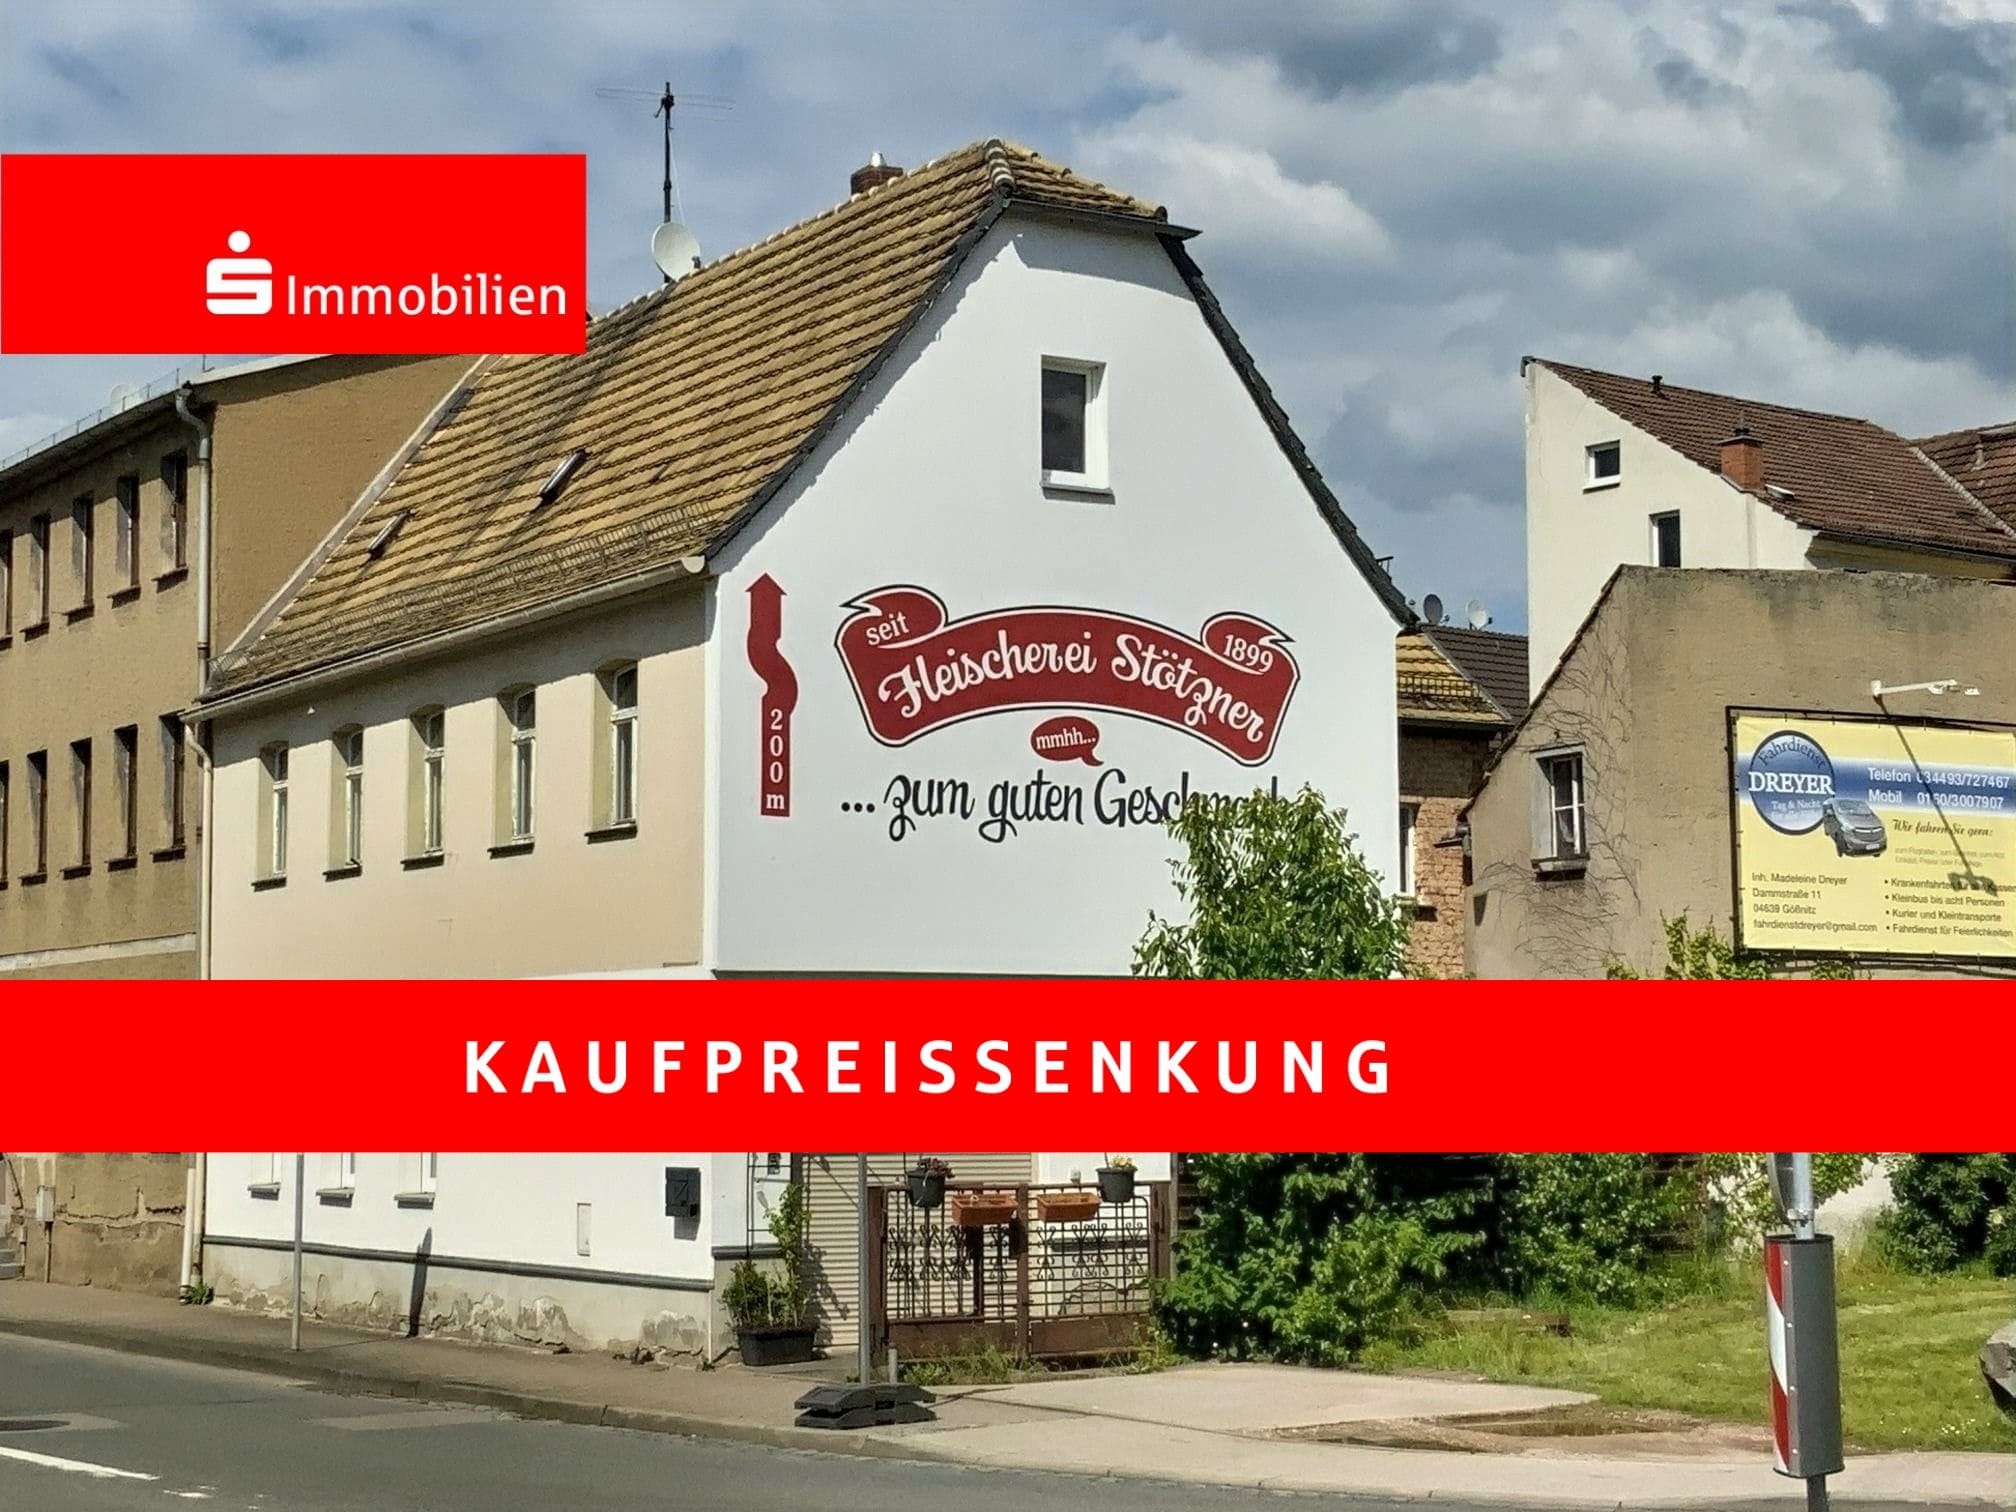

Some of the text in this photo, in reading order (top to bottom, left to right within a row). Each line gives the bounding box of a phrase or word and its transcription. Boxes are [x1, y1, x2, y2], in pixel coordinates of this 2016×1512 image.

[865, 611, 910, 646] seit
[1223, 633, 1274, 673] 1899
[878, 629, 1264, 743] Fleischerei Stötzner
[1758, 736, 1826, 769] Fahrdienst
[1748, 771, 1836, 795] DREYER
[1867, 767, 1912, 783] Telefon
[1868, 789, 1903, 804] Mobil
[884, 773, 975, 842] zum
[978, 769, 1084, 843] guten
[1094, 768, 1284, 830] Gesch
[1892, 819, 1912, 832] Wir
[1915, 821, 1949, 835] fahren
[1952, 822, 1964, 835] Sie
[1752, 872, 1848, 886] Inh. Madeleine Dreyer
[1752, 887, 1822, 899] Dammstraße 11
[1891, 893, 2005, 908] Kleinbus bis acht Personen
[1892, 908, 2002, 924] Kurier und Kleintransporte
[1753, 919, 1878, 933] fahrdienstdreyer@gmail.com
[1892, 923, 2014, 938] Fahrdienst für Feierlichkeiten
